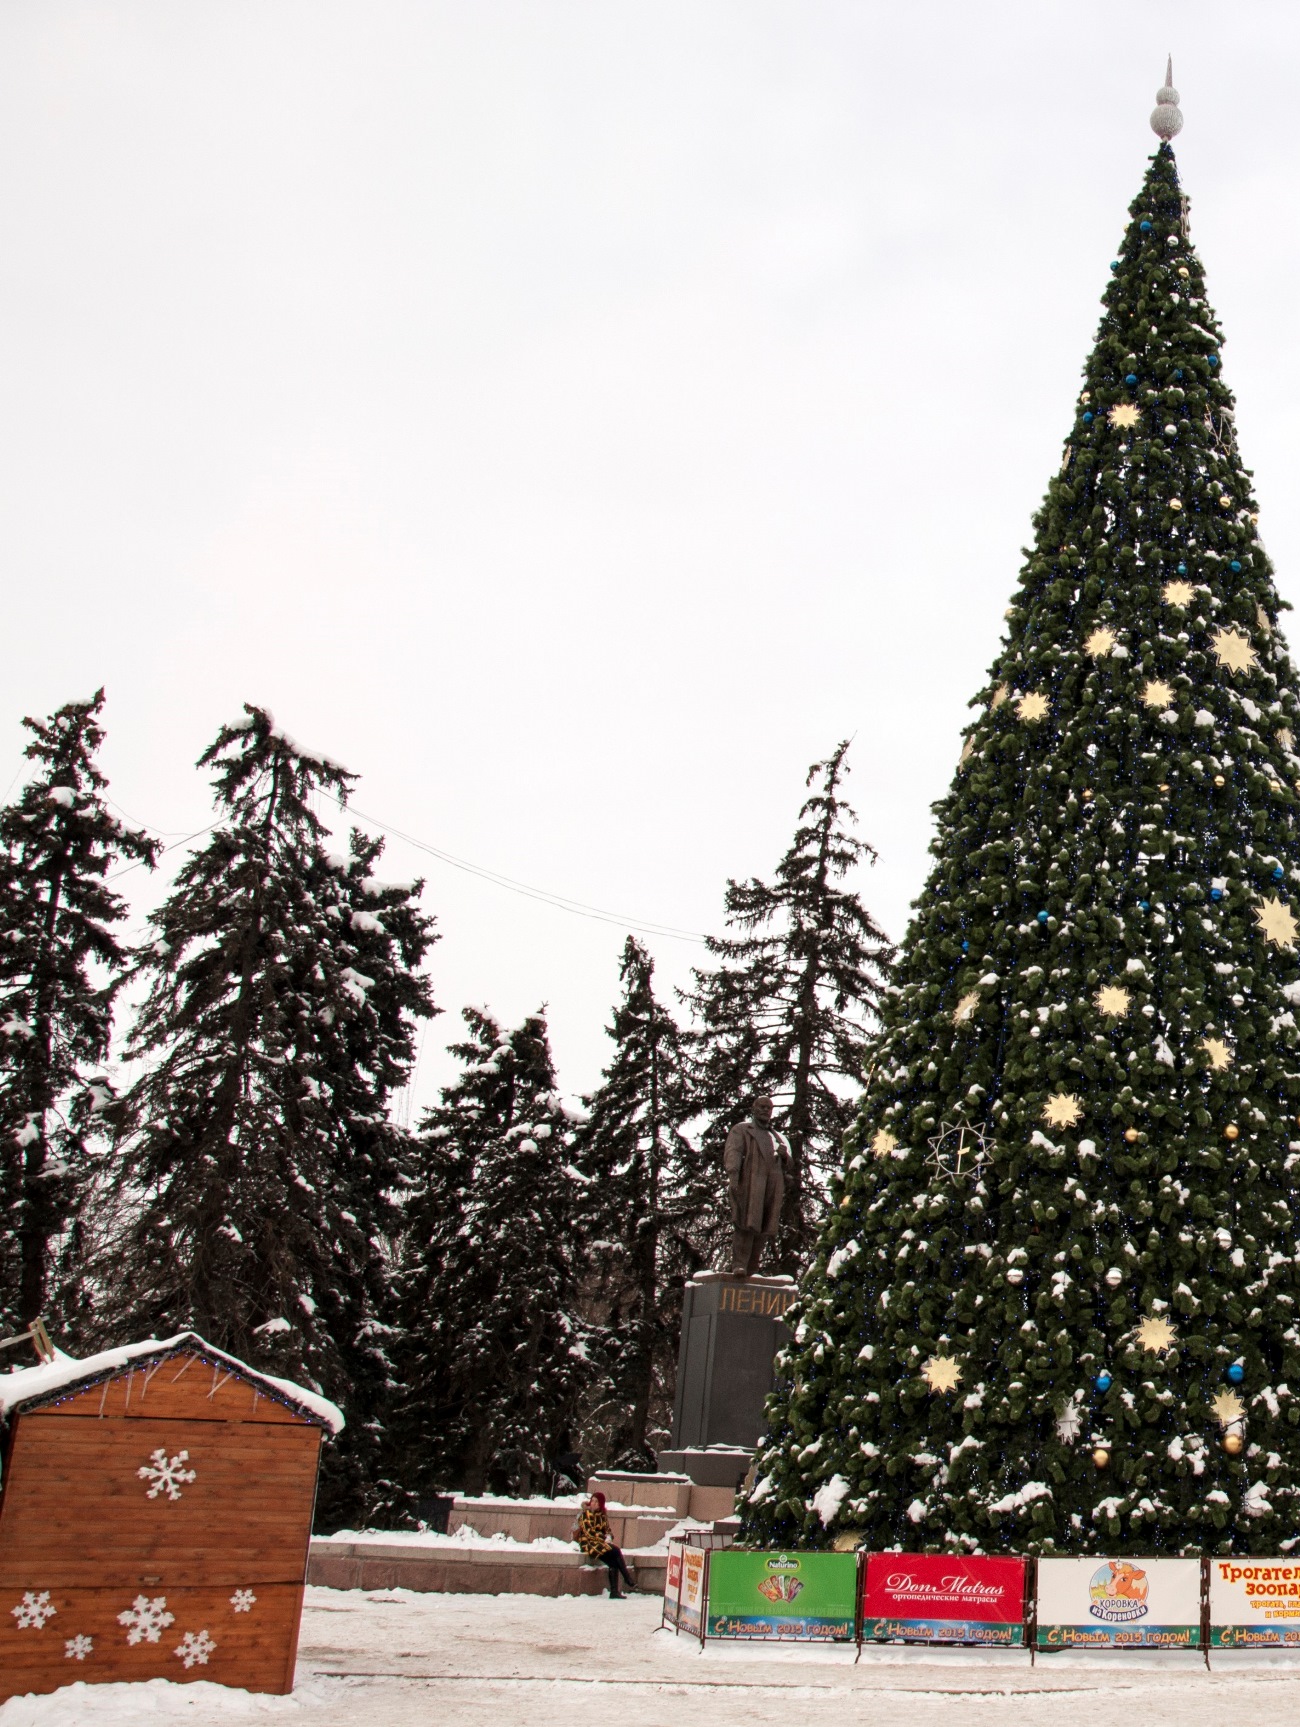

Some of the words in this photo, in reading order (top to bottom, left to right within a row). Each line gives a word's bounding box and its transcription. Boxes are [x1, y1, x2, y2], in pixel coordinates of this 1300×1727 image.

[720, 1287, 796, 1315] ЛЕНИН
[769, 1561, 798, 1569] Naturino
[886, 1573, 937, 1593] Don
[938, 1575, 1005, 1595] Matras
[892, 1593, 960, 1602] ортопедические
[962, 1595, 998, 1604] матрасы
[1099, 1600, 1139, 1609] КОРОВКА
[777, 1625, 803, 1634] 2015
[938, 1628, 965, 1638] 2015
[1115, 1632, 1142, 1643] 2015
